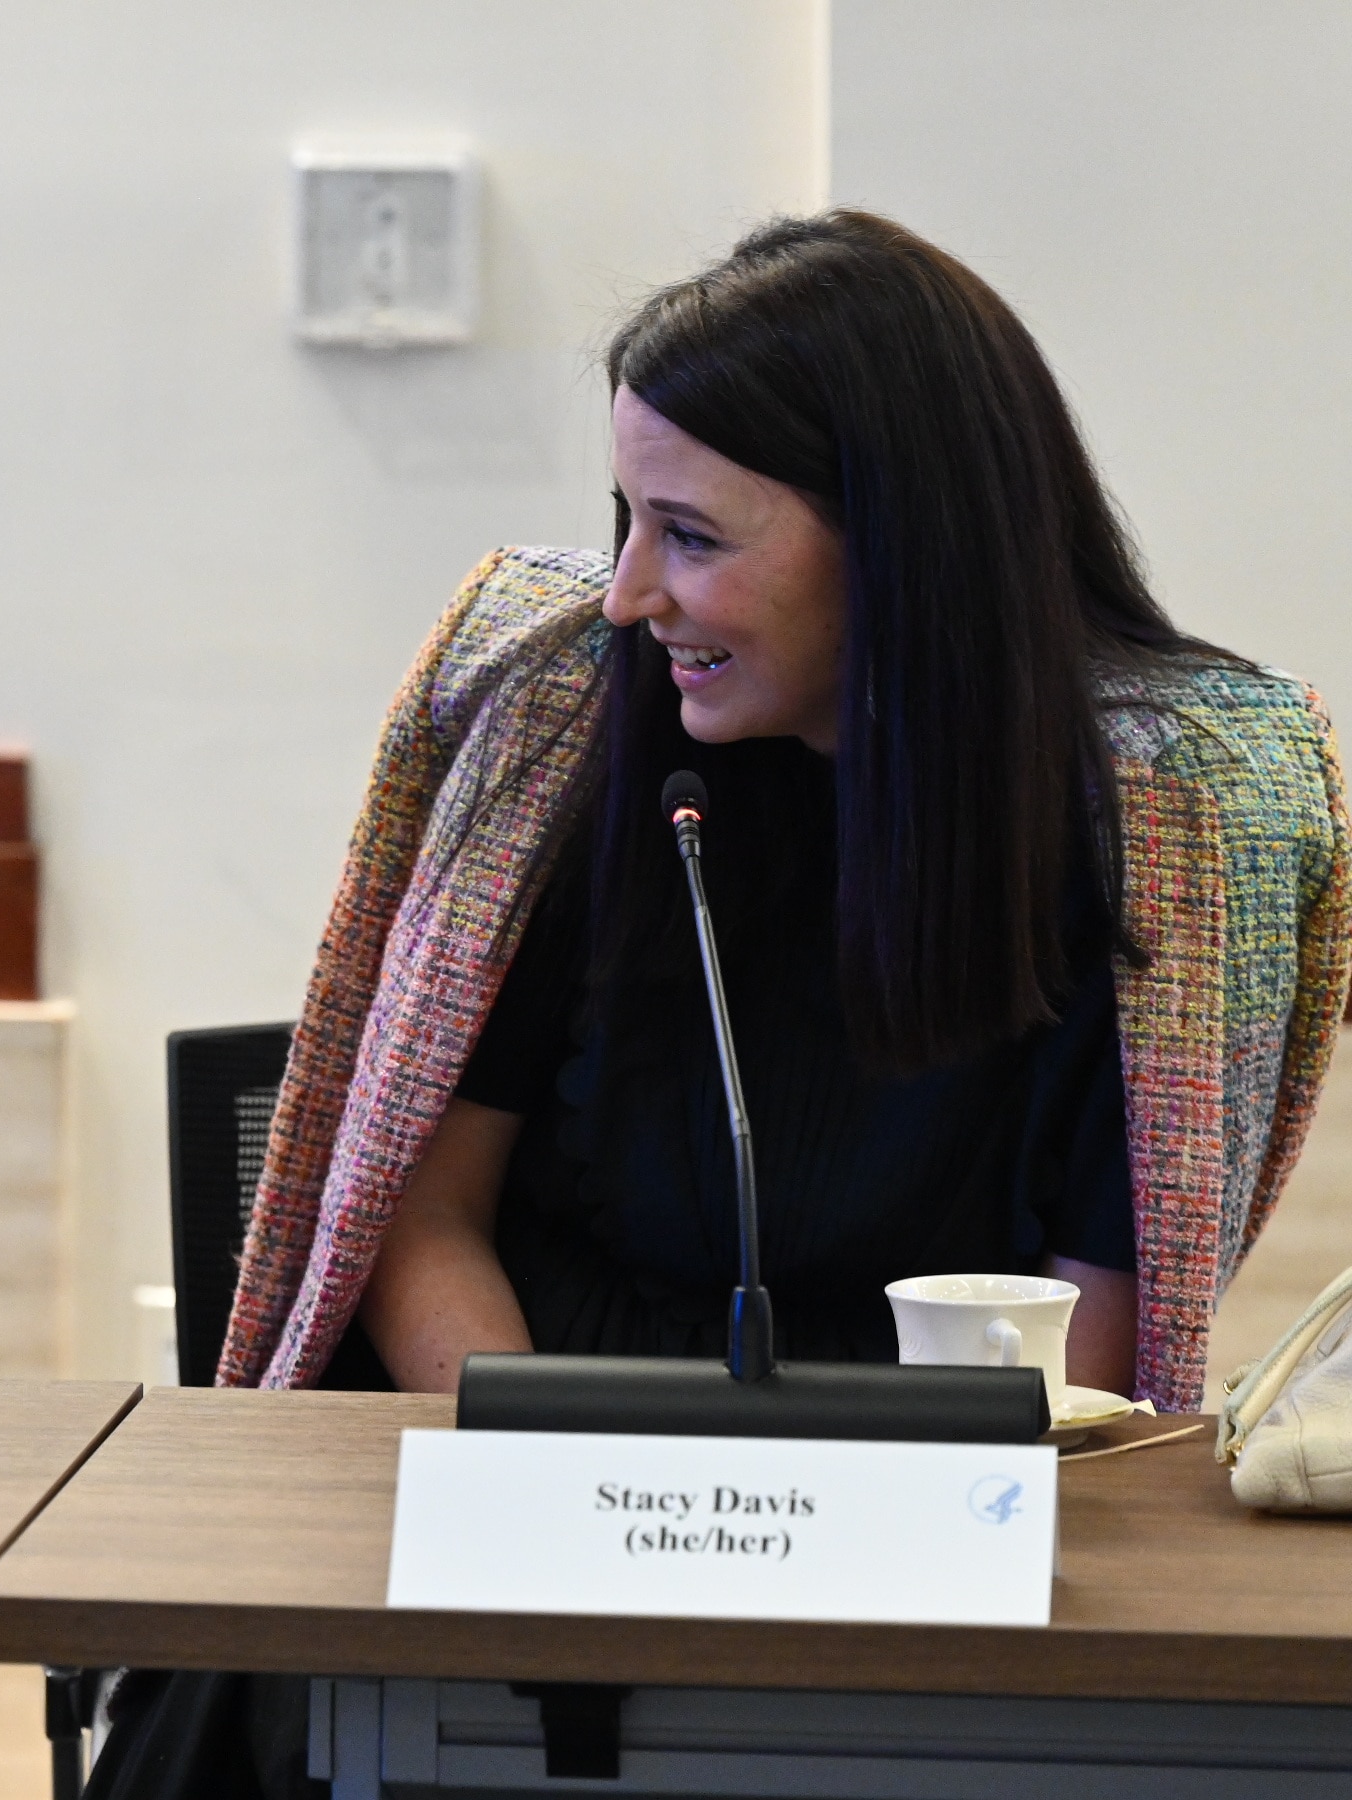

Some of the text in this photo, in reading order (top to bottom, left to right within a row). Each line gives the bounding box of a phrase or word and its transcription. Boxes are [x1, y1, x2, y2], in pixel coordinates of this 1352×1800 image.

[596, 1484, 815, 1520] Stacy Davis
[625, 1525, 791, 1559] (she/her)
